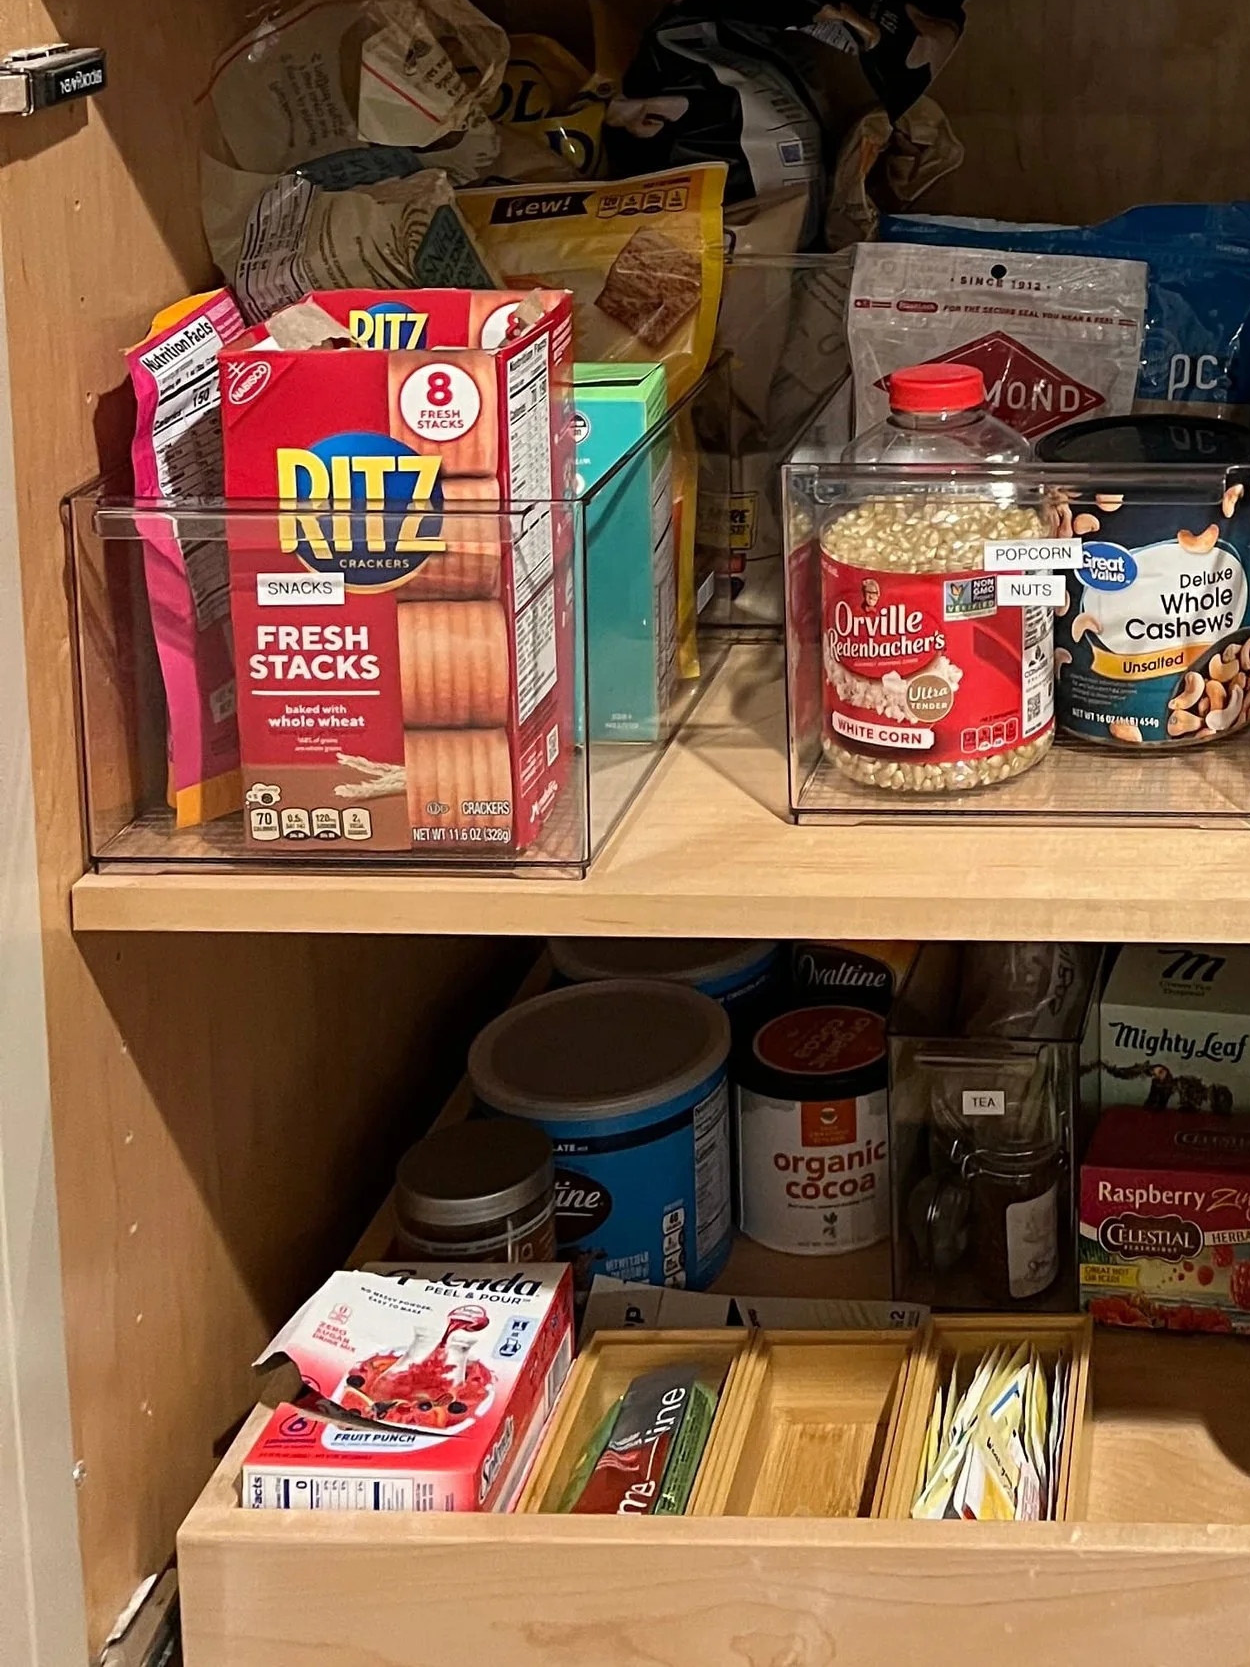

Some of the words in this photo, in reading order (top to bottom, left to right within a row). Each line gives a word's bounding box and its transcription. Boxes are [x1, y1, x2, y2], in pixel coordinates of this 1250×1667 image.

[960, 276, 1004, 289] SINCE
[1011, 280, 1042, 291] 1912
[349, 310, 429, 350] RITZ
[142, 336, 190, 373] Nutrition
[188, 320, 213, 347] Facts
[232, 363, 267, 403] NABISCO
[426, 371, 452, 407] 8
[192, 388, 210, 408] 150
[417, 419, 465, 430] STACKS
[420, 409, 461, 420] FRESH
[277, 448, 446, 560] RITZ
[339, 558, 409, 569] CRACKERS
[995, 547, 1072, 562] POPCORN
[1082, 553, 1125, 573] Great
[1091, 568, 1125, 583] Value
[1180, 567, 1233, 589] Deluxe
[267, 581, 333, 595] SNACKS
[1010, 584, 1052, 597] NUTS
[1161, 588, 1233, 615] Whole
[835, 601, 922, 637] Orville
[1126, 612, 1233, 640] Cashews
[257, 625, 369, 651] FRESH
[828, 630, 945, 662] Redenbacher's
[250, 654, 380, 681] STACKS
[1123, 652, 1184, 674] Unsalted
[908, 685, 948, 702] Ultra
[285, 704, 320, 715] baked
[322, 704, 347, 715] with
[911, 702, 947, 711] TENDER
[268, 715, 315, 728] whole
[318, 715, 365, 728] wheat
[838, 719, 874, 740] WHITE
[878, 730, 922, 745] CORN
[462, 802, 510, 815] CRACKERS
[413, 828, 430, 841] NET
[431, 828, 446, 841] WT
[449, 828, 468, 841] 11.6
[470, 828, 482, 841] OZ
[483, 827, 512, 842] (328g)
[1109, 1021, 1197, 1060] Mighty
[1195, 1032, 1249, 1063] Leaf
[972, 1097, 996, 1108] TEA
[774, 1140, 887, 1182] organic
[785, 1172, 876, 1199] cocoa
[1098, 1181, 1205, 1210] Raspberry
[1106, 1223, 1195, 1248] CELESTIAL
[425, 1285, 455, 1298] PEEL
[465, 1290, 474, 1299] &
[479, 1293, 522, 1305] POUR
[316, 1328, 351, 1345] SUGAR
[319, 1320, 347, 1336] ZERO
[334, 1432, 371, 1443] FRUIT
[373, 1433, 416, 1444] PUNCH
